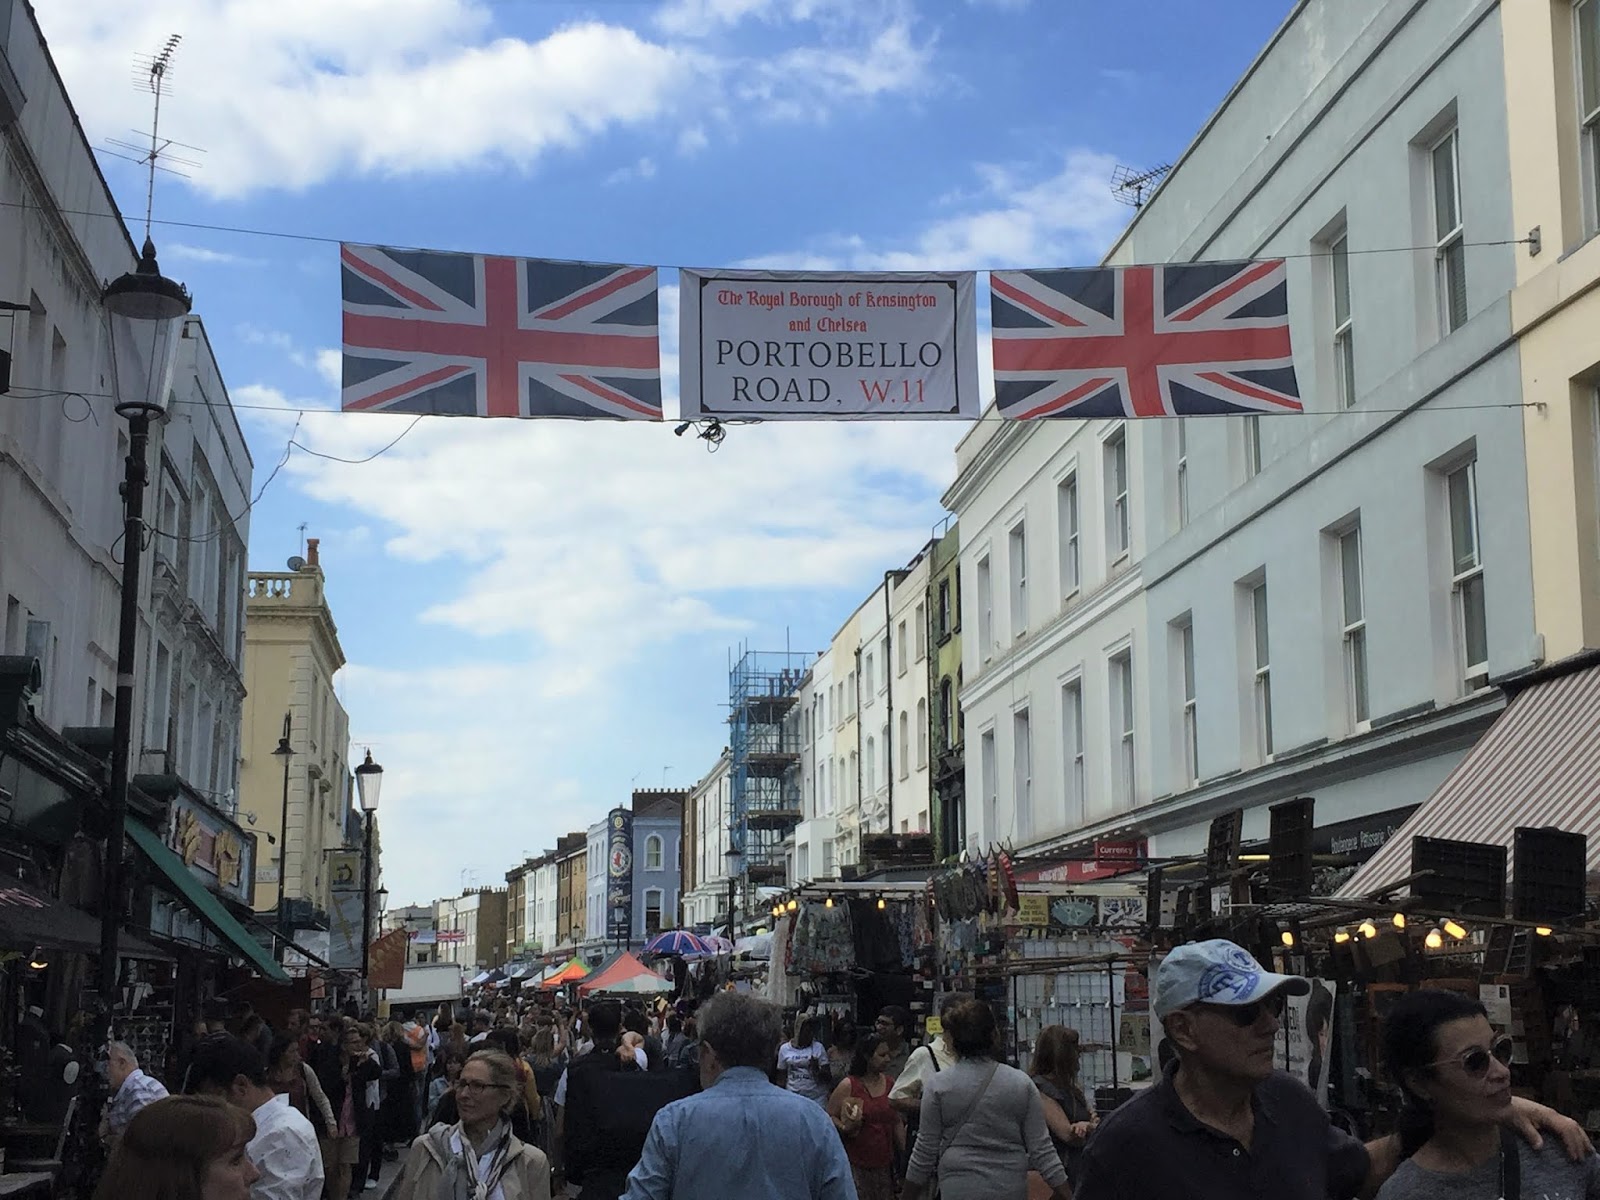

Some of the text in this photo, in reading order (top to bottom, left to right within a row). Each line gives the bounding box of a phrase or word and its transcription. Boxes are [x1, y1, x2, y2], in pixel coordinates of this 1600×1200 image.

[718, 290, 937, 311] The Royal Borough of Kensington
[788, 316, 867, 332] and Chelsea
[716, 339, 942, 368] PORTOBELLO
[732, 376, 926, 405] ROAD, W.11
[1099, 846, 1134, 855] Currency
